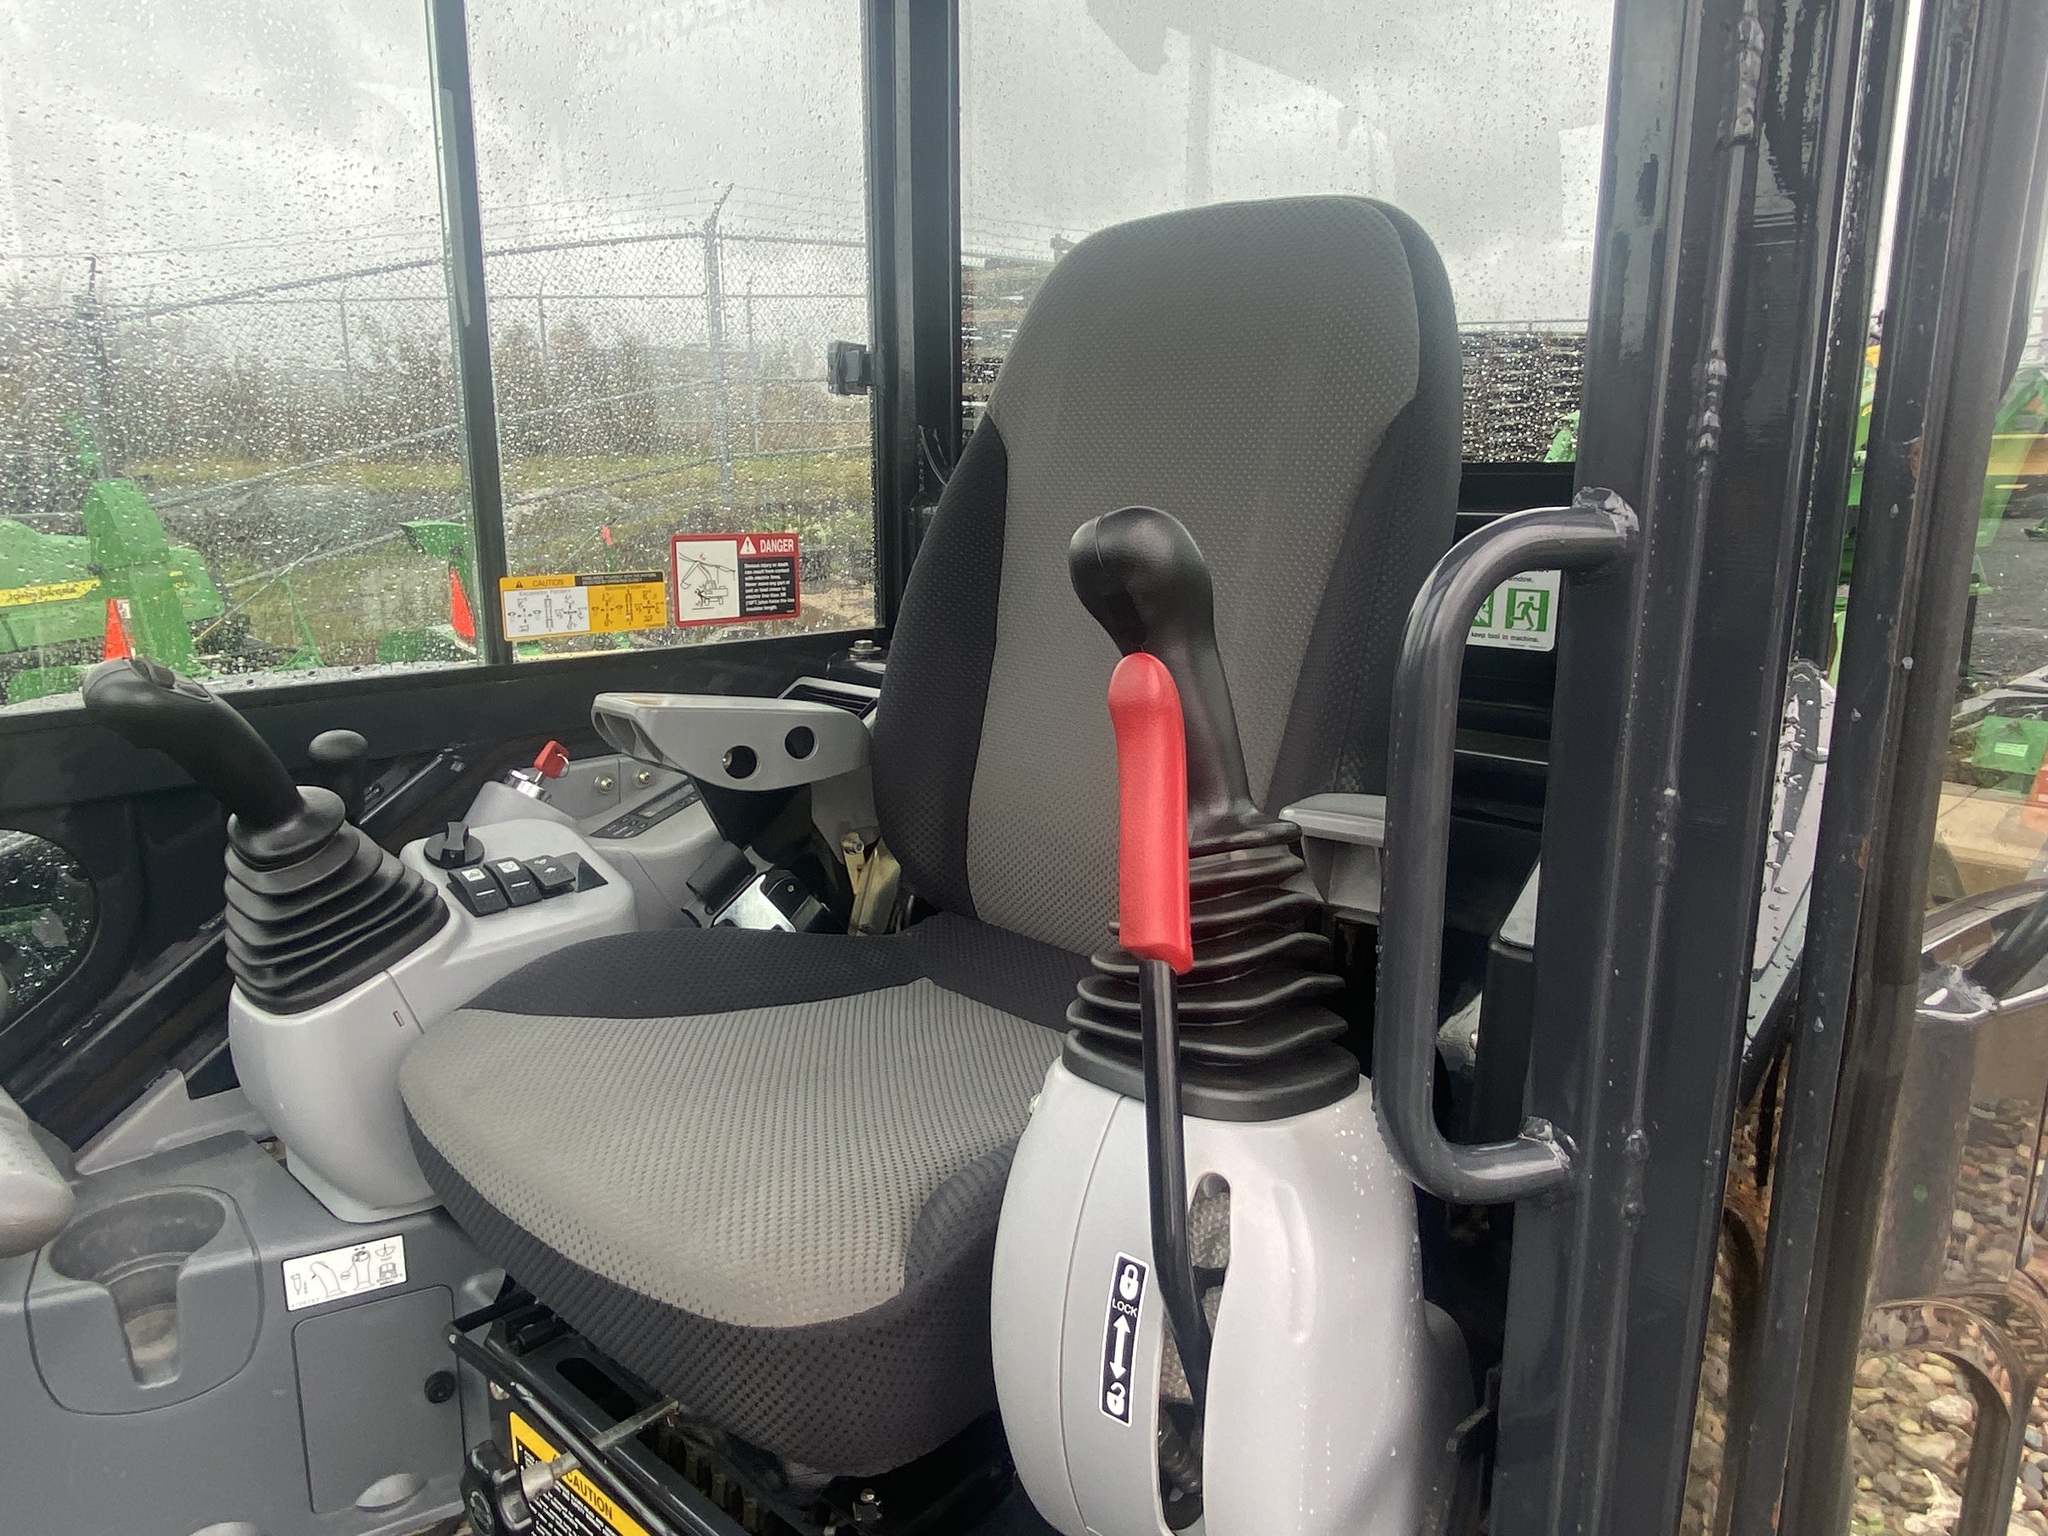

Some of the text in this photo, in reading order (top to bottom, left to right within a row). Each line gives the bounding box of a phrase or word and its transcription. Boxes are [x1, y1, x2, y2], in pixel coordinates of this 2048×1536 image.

[760, 538, 794, 553] DANGER
[532, 579, 564, 587] CAUTION
[1471, 631, 1486, 639] keep
[1510, 635, 1540, 643] machine.
[1112, 1298, 1138, 1318] LOCK
[566, 1471, 614, 1521] CAUTION
